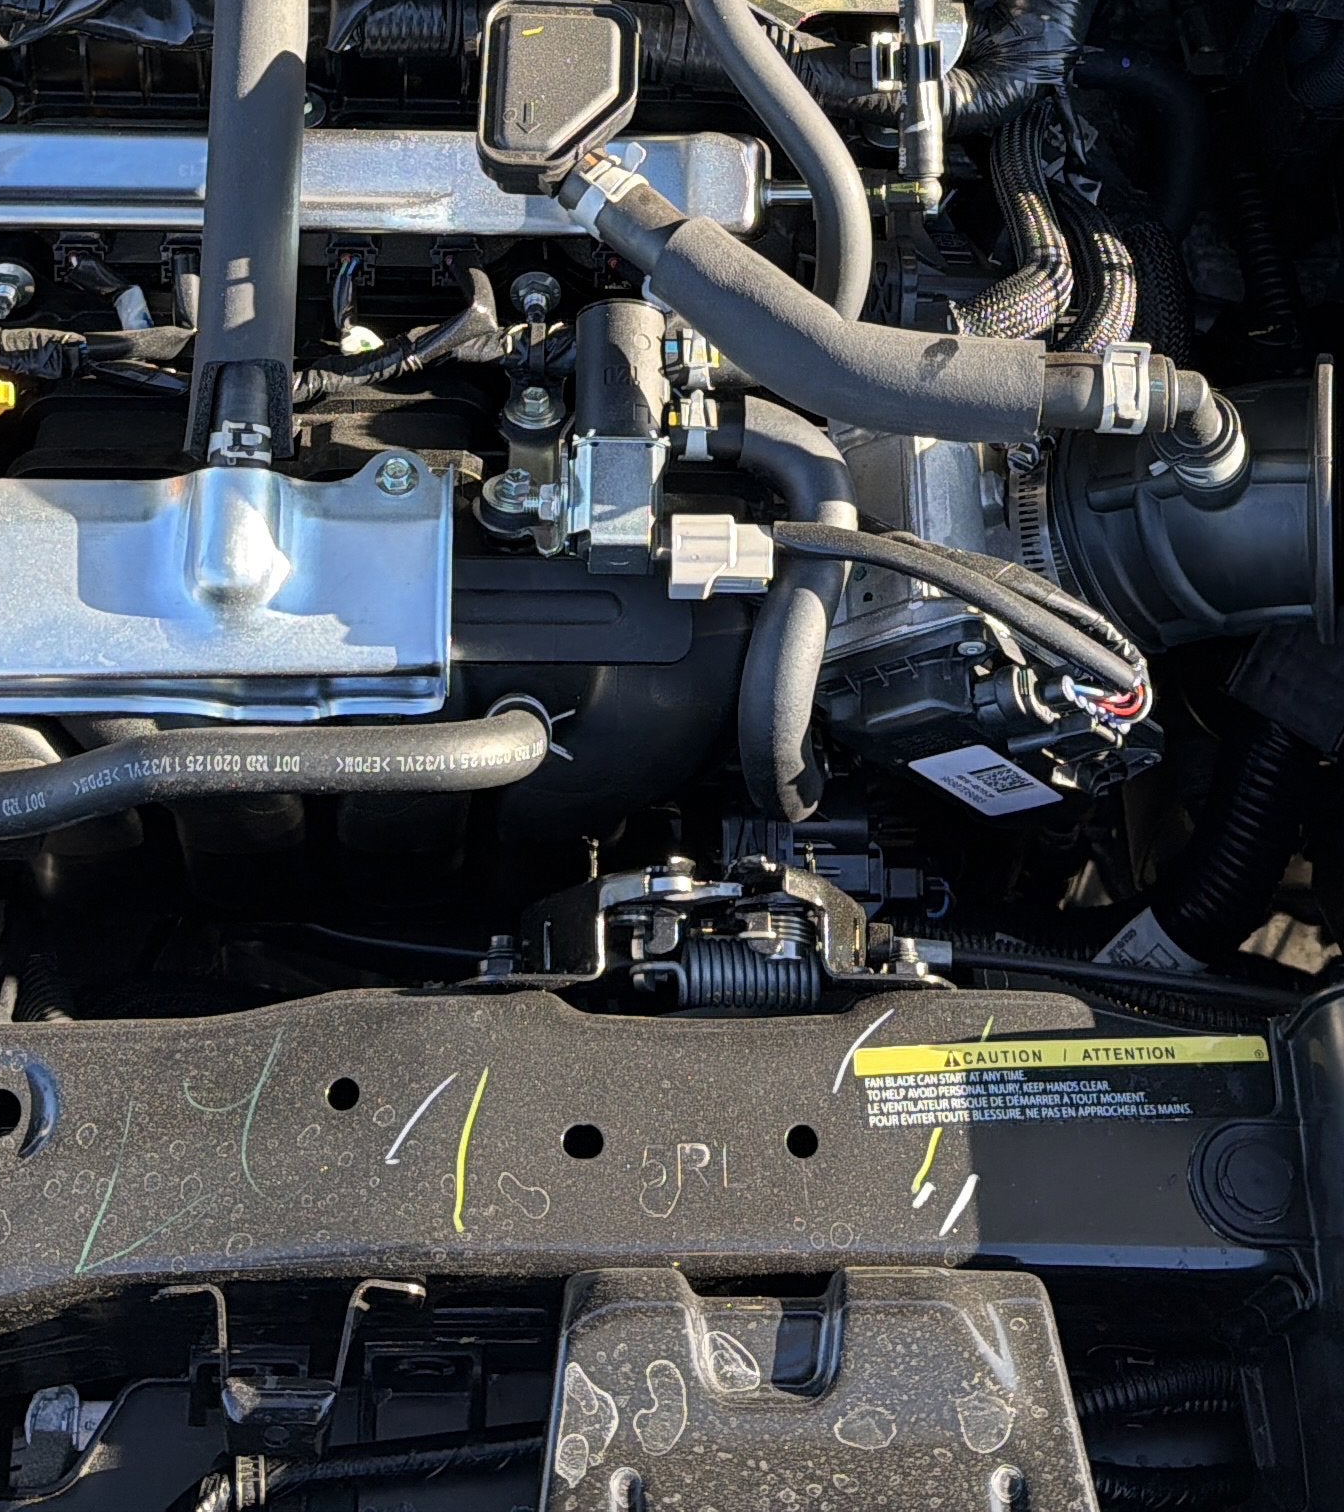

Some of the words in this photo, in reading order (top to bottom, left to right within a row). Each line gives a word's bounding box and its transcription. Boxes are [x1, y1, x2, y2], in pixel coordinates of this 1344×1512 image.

[186, 754, 241, 773] 020125
[274, 754, 300, 772] DOT
[25, 792, 47, 814] DOT
[962, 1049, 1043, 1065] CAUTION
[1082, 1046, 1176, 1062] ATTENTION
[865, 1077, 885, 1089] FAN
[885, 1075, 916, 1088] BLADE
[917, 1074, 938, 1086] CAN
[939, 1072, 967, 1084] START
[969, 1072, 981, 1082] AT
[867, 1090, 881, 1101] TO
[882, 1088, 906, 1100] HELP
[907, 1087, 937, 1099] AVOID
[938, 1085, 987, 1097] PERSONAL
[989, 1083, 1021, 1095] INJURY,
[1023, 1082, 1045, 1094] KEEP
[1046, 1080, 1079, 1093] HANDS
[1080, 1080, 1111, 1092] CLEAR.
[867, 1103, 880, 1115] LE
[881, 1099, 949, 1114] VENTILATEUR
[951, 1097, 989, 1110] RISQUE
[990, 1097, 1005, 1108] DE
[1006, 1093, 1060, 1107] DÉMARRER
[1062, 1091, 1071, 1104] À
[1071, 1093, 1098, 1104] TOUT
[1100, 1091, 1148, 1104] MOMENT.
[869, 1115, 900, 1128] POUR
[900, 1112, 935, 1126] ÉVITER
[938, 1112, 970, 1124] TOUTE
[972, 1109, 1024, 1121] BLESSURE,
[1026, 1108, 1040, 1119] NE
[1041, 1107, 1060, 1119] PAS
[1062, 1107, 1076, 1118] EN
[1077, 1104, 1138, 1118] APPROCHER
[1139, 1104, 1156, 1116] LES
[1158, 1102, 1194, 1115] MAINS.
